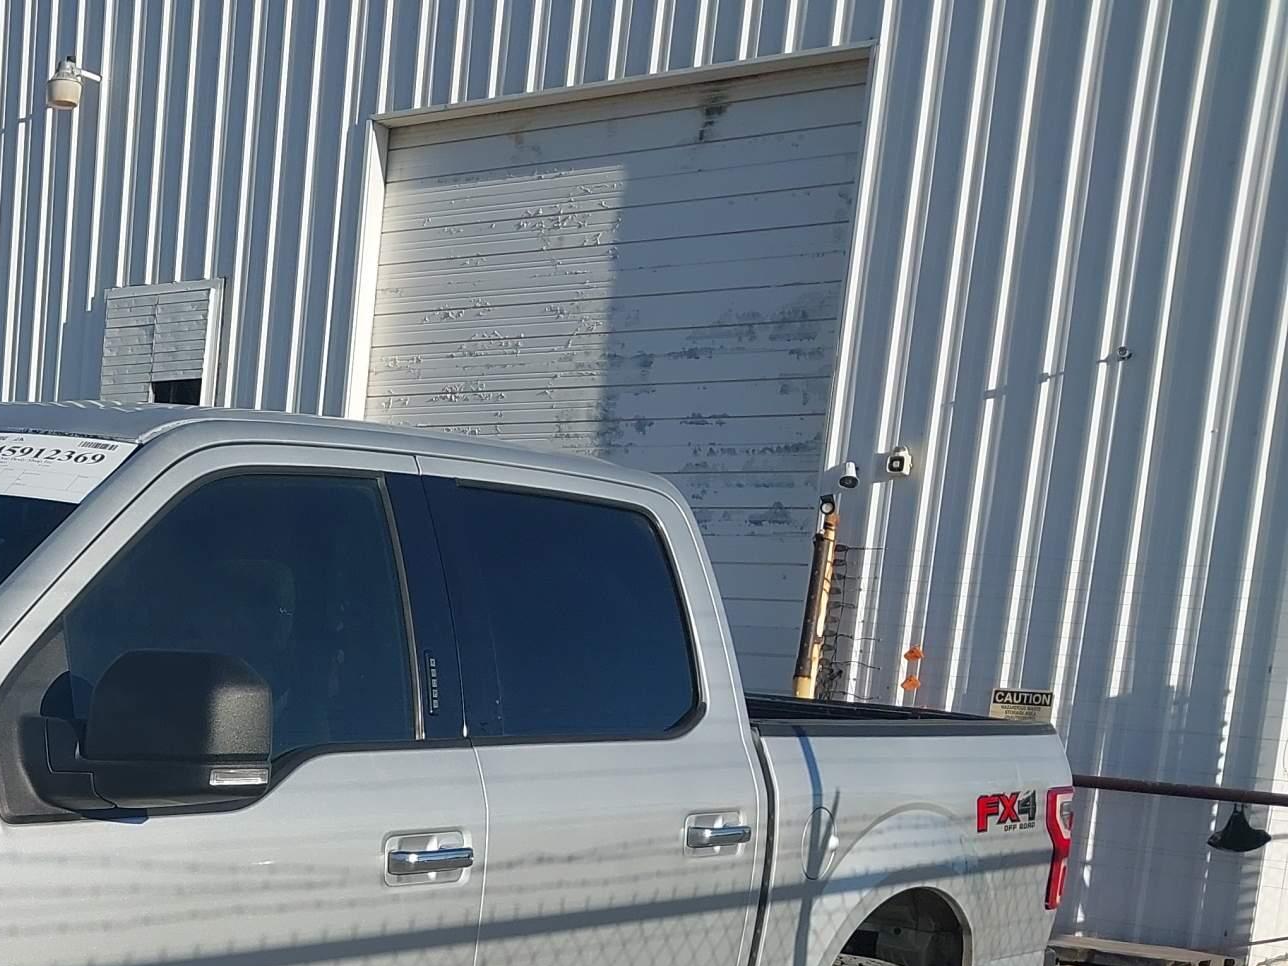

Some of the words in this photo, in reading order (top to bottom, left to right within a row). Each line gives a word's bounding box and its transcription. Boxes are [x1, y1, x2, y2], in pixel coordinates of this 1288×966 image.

[995, 691, 1051, 706] CAUTION
[976, 789, 1037, 833] FX4
[1004, 824, 1016, 832] OFF
[1019, 821, 1036, 831] ROAD
